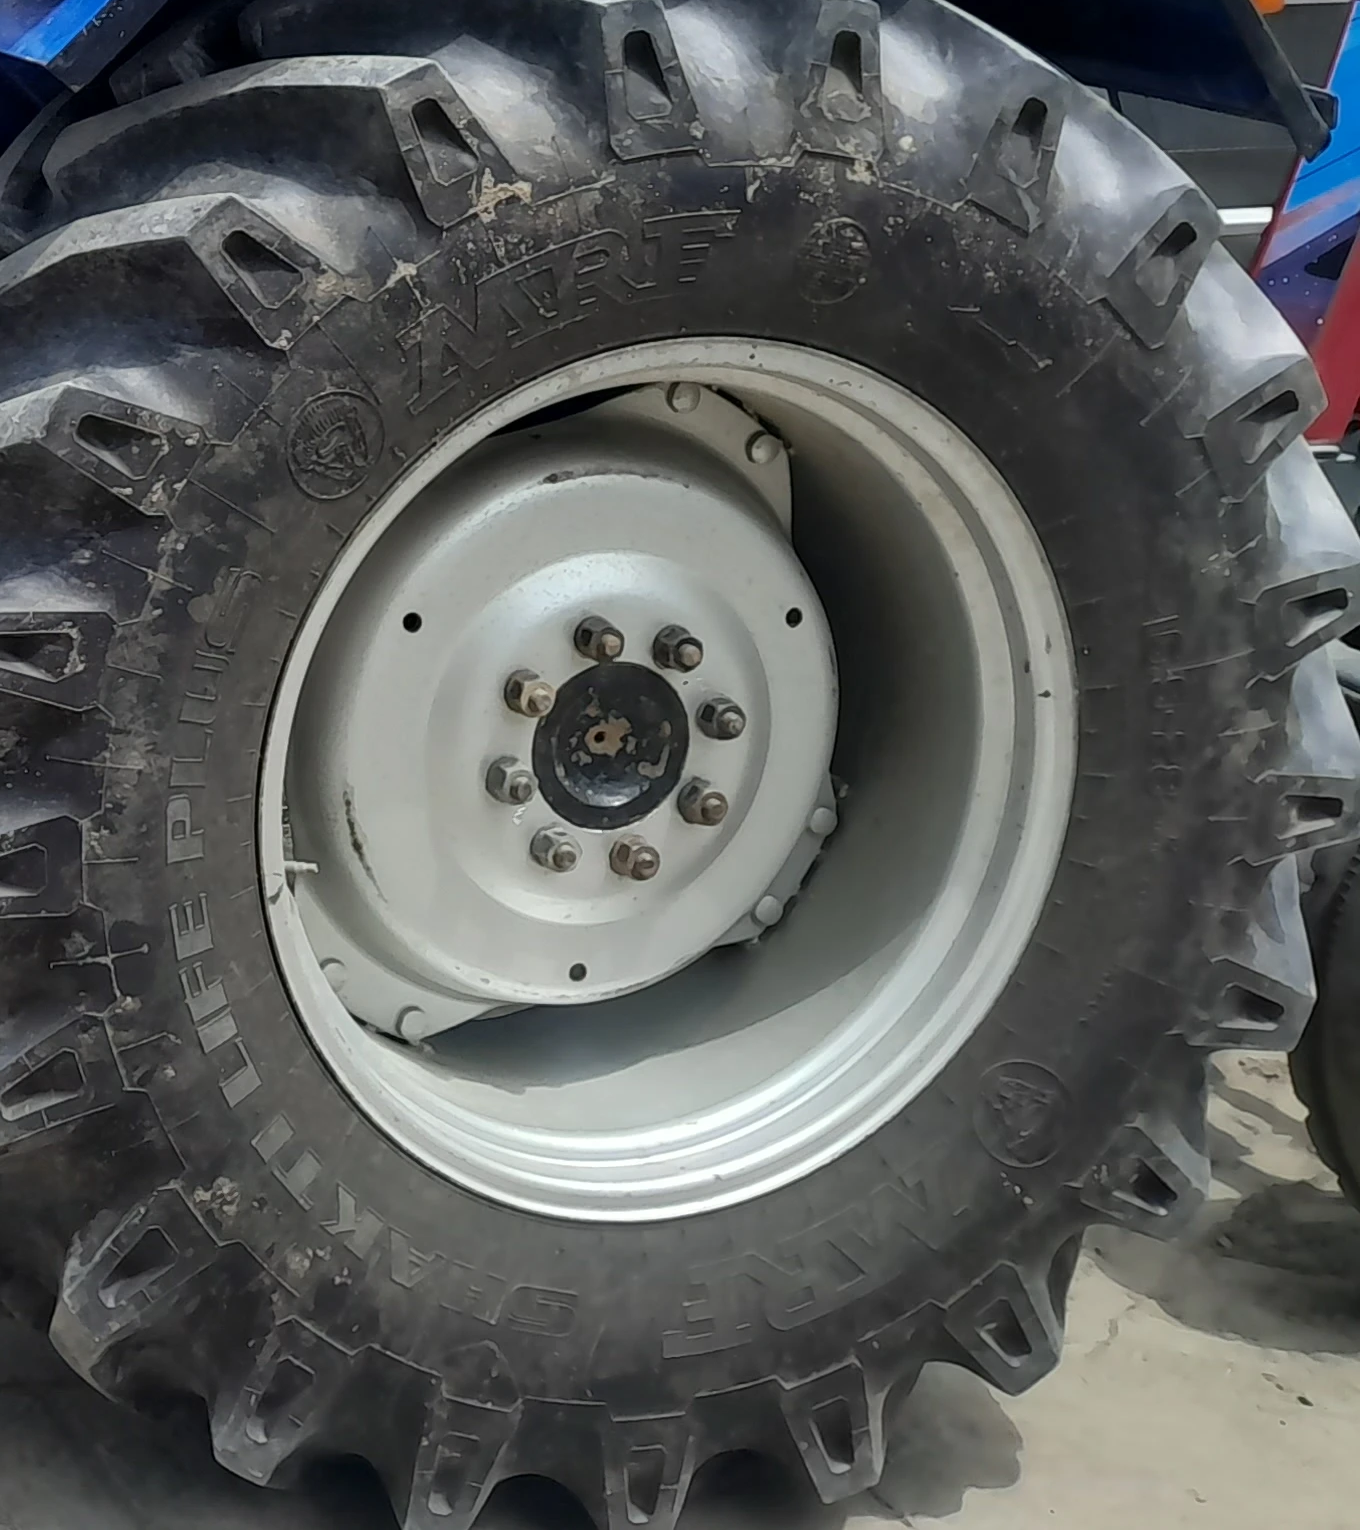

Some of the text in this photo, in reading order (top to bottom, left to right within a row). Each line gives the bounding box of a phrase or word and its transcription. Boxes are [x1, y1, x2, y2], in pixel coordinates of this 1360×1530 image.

[166, 566, 579, 1338] SHAKTI LIFE PLUS
